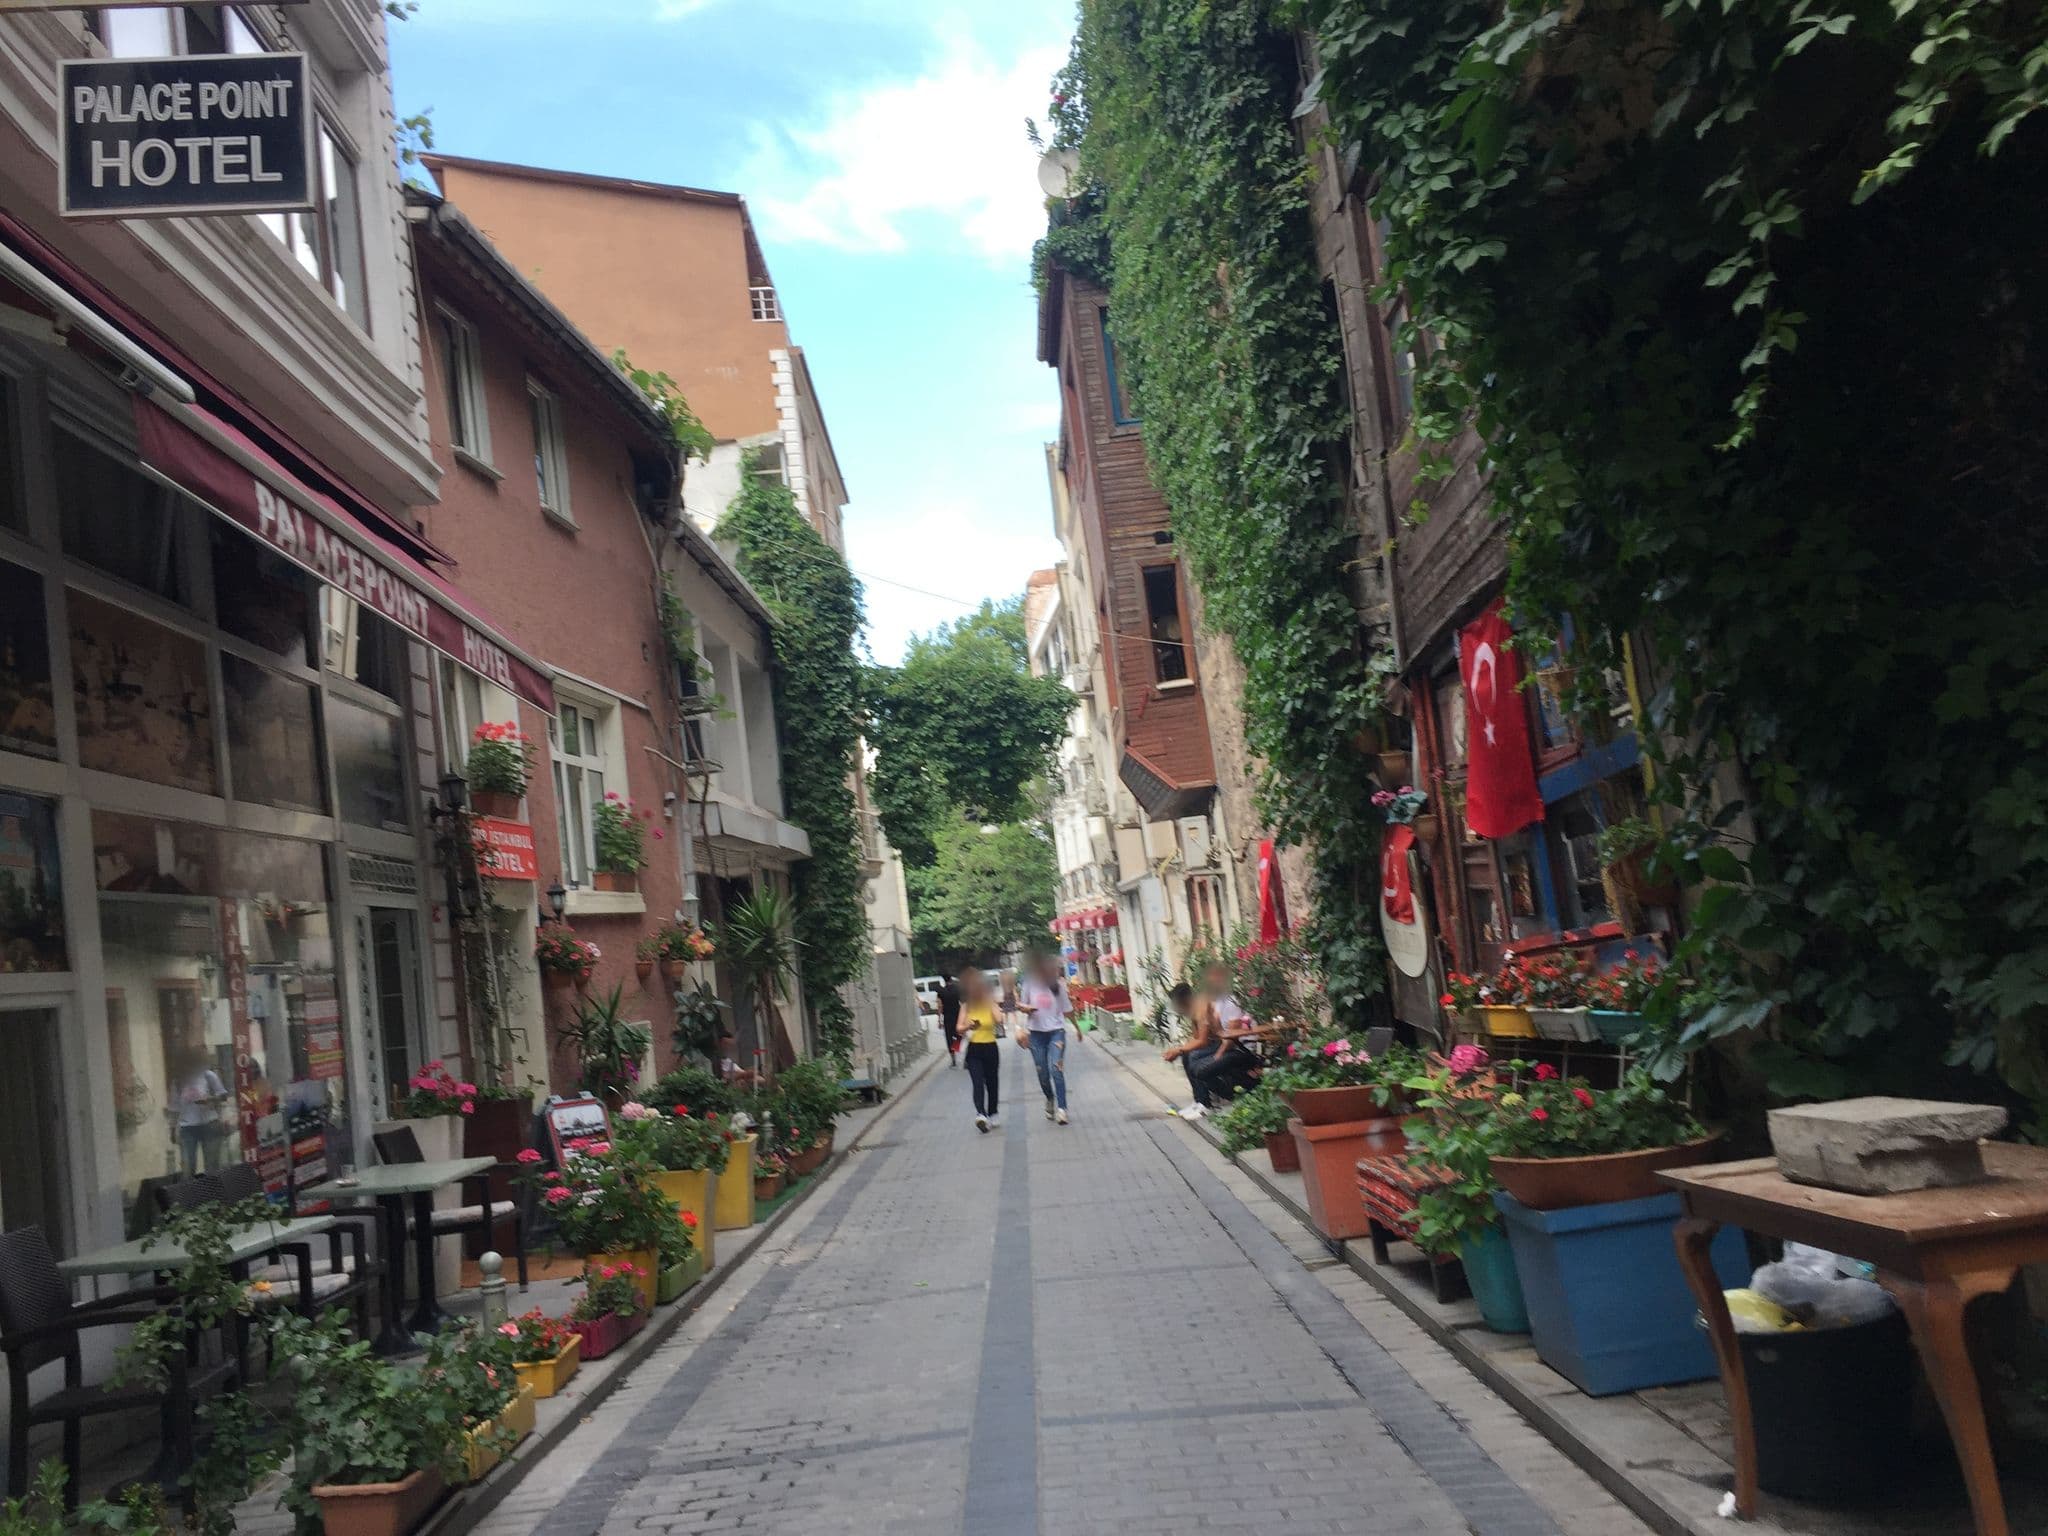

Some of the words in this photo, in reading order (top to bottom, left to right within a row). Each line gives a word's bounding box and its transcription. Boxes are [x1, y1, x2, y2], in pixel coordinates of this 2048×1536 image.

[74, 82, 193, 123] PALACE
[199, 79, 293, 120] POINT
[91, 135, 283, 188] HOTEL
[462, 624, 515, 691] HOTEL
